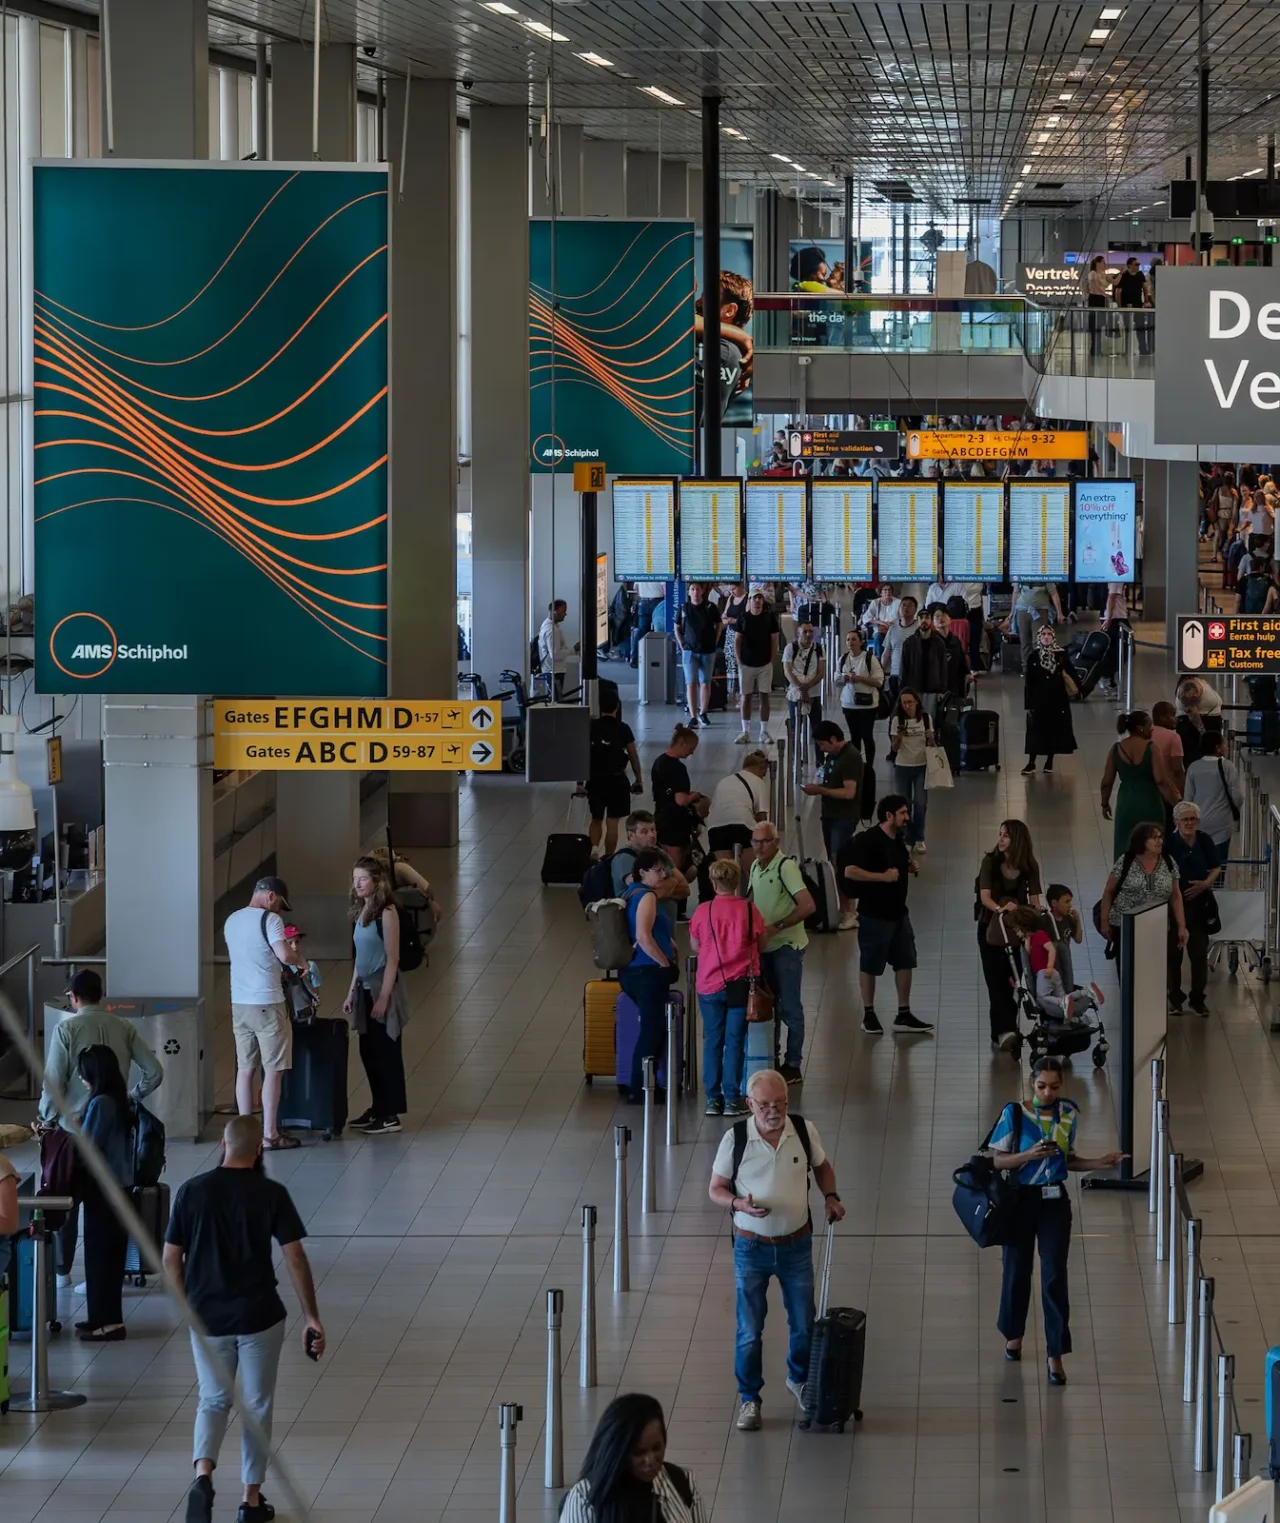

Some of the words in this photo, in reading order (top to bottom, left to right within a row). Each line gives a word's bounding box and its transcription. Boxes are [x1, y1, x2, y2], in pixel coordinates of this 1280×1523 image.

[1025, 266, 1079, 280] Vertrek
[968, 434, 984, 443] 2-3
[1032, 434, 1056, 444] 9-32
[565, 448, 598, 458] Schiphol
[840, 444, 874, 452] validation
[1080, 494, 1092, 502] An
[1094, 494, 1116, 502] extra
[1080, 503, 1100, 511] 10%
[1102, 502, 1115, 511] off
[1229, 620, 1258, 631] First
[1229, 633, 1254, 642] Eerste
[1256, 632, 1276, 642] hulp
[71, 644, 113, 659] AMS
[117, 644, 188, 662] Schiphol
[1229, 648, 1250, 659] Tax
[1254, 646, 1280, 659] free
[1229, 660, 1264, 668] Customs
[224, 710, 270, 724] Gates
[274, 706, 382, 729] EFGHM
[394, 706, 412, 729] D
[414, 712, 439, 724] 1-57
[246, 744, 290, 759] Gates
[295, 741, 358, 764] ABC
[370, 742, 388, 763] D
[392, 745, 436, 758] 59-87
